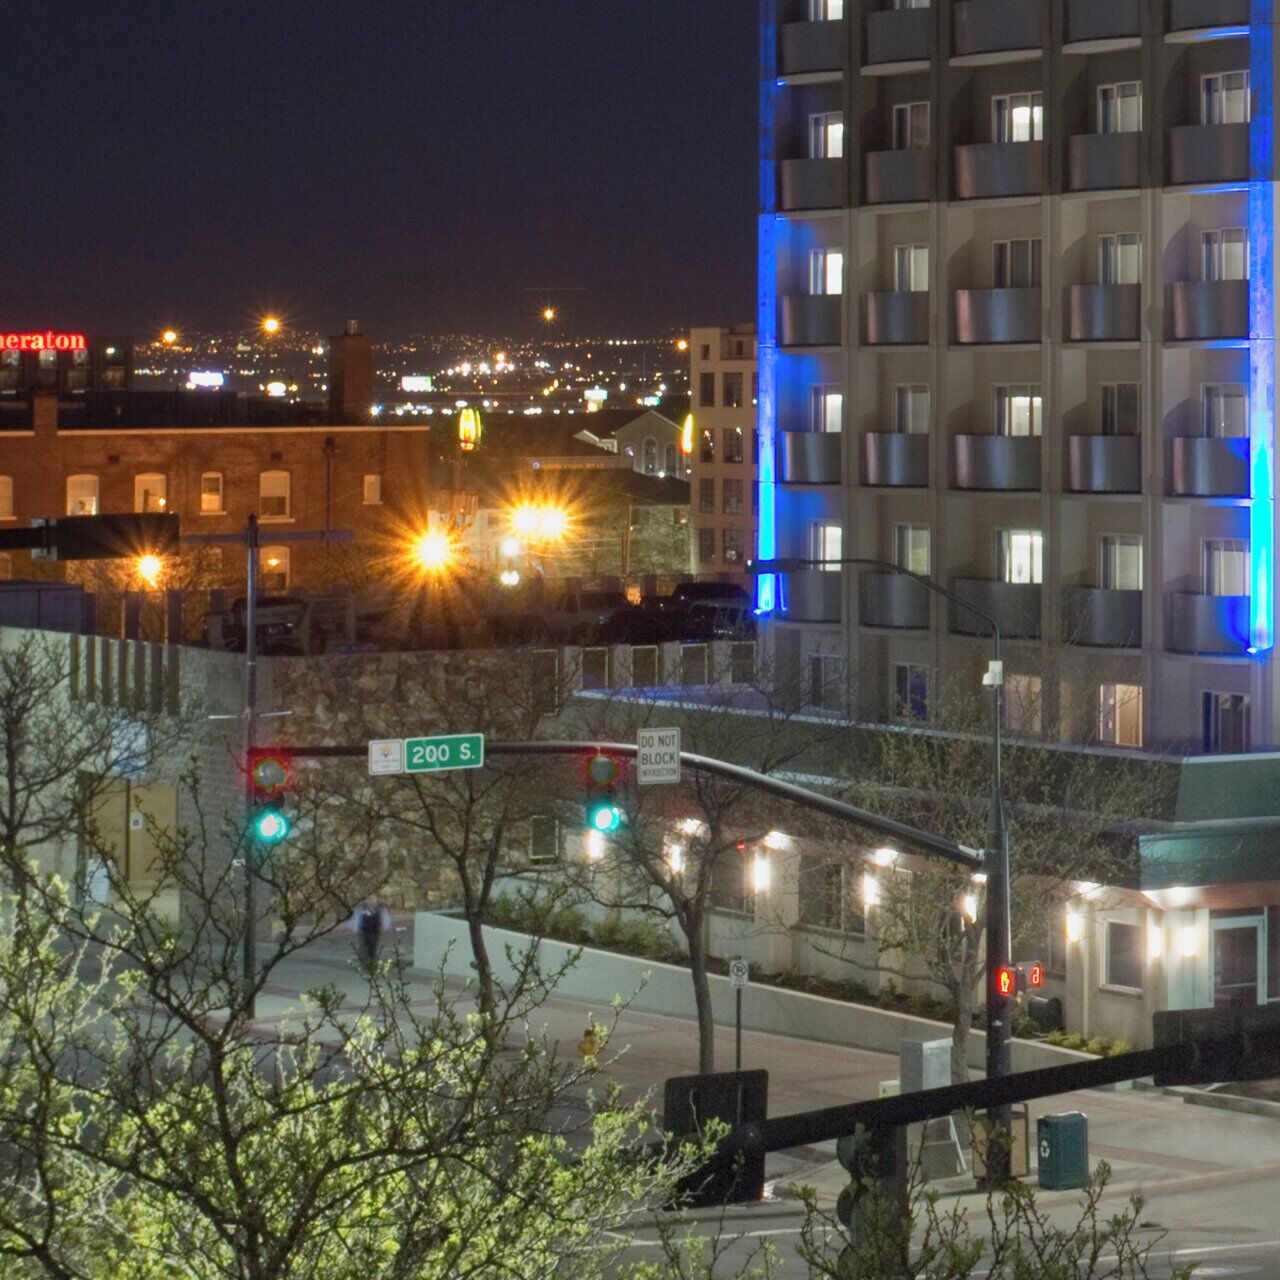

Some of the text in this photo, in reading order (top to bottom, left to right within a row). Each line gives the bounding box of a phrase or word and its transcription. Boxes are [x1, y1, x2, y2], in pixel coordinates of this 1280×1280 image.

[641, 735, 676, 748] DO NOT
[412, 742, 476, 764] 200 S.
[641, 752, 676, 766] BLOCK
